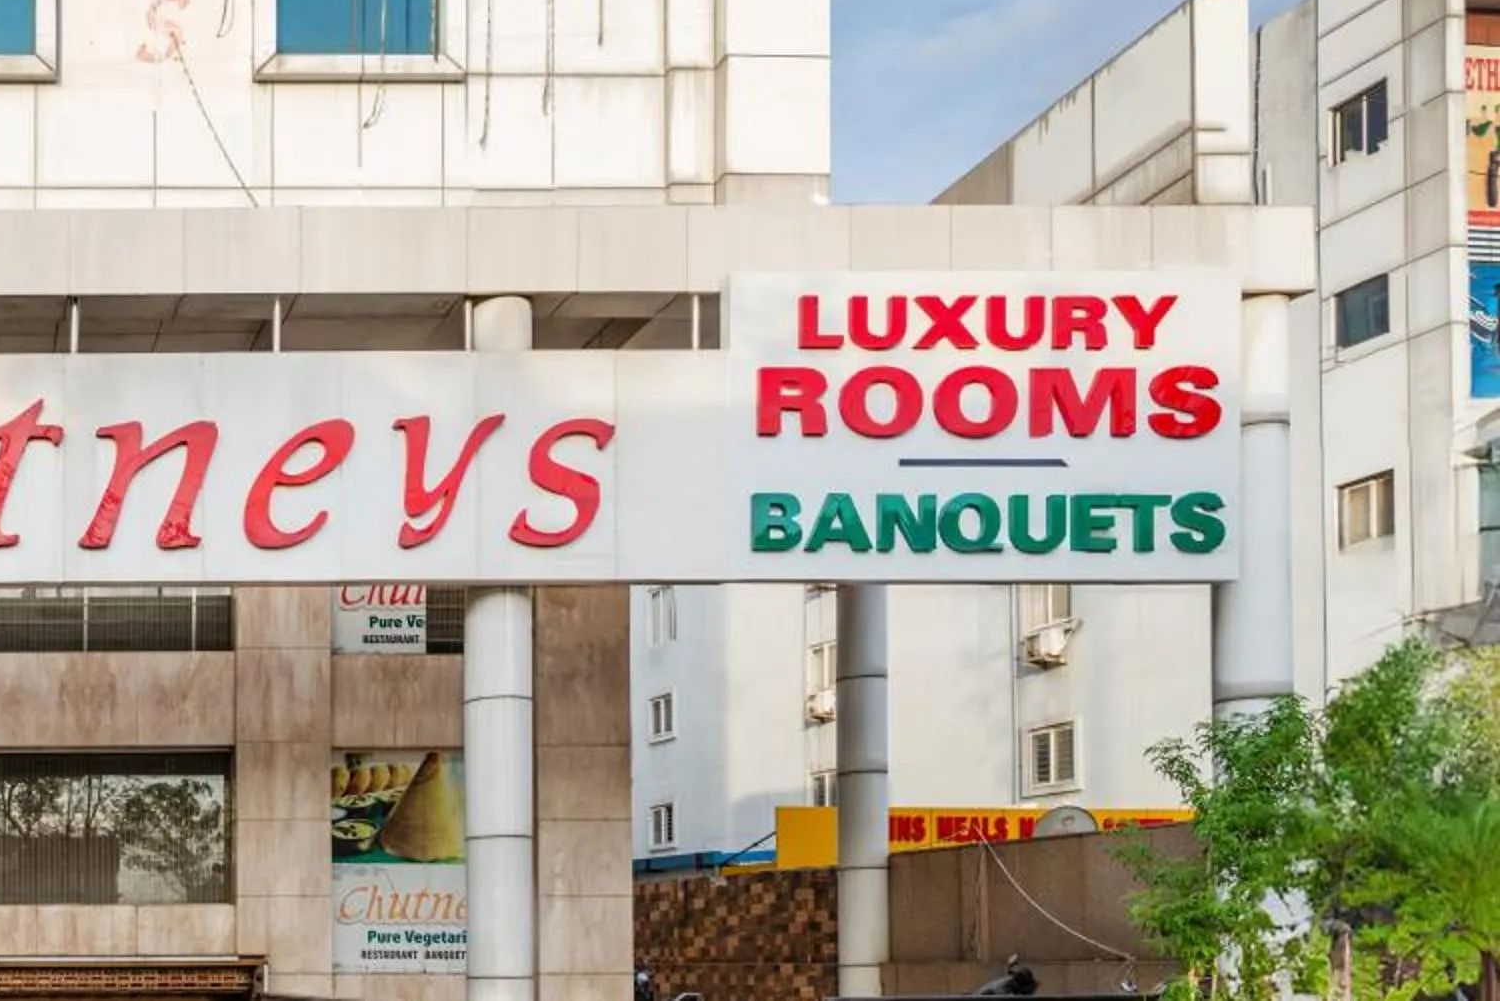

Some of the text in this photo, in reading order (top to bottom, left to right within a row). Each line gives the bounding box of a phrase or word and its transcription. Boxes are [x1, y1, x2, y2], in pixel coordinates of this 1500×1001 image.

[798, 295, 1178, 351] LUXURY
[756, 366, 1222, 439] ROOMS
[750, 492, 1226, 554] BANQUETS
[369, 615, 403, 629] Pure
[362, 635, 420, 644] RESTAURANT
[937, 816, 1009, 842] MEALS
[367, 930, 401, 944] Pure
[361, 950, 418, 960] RESTAURANT
